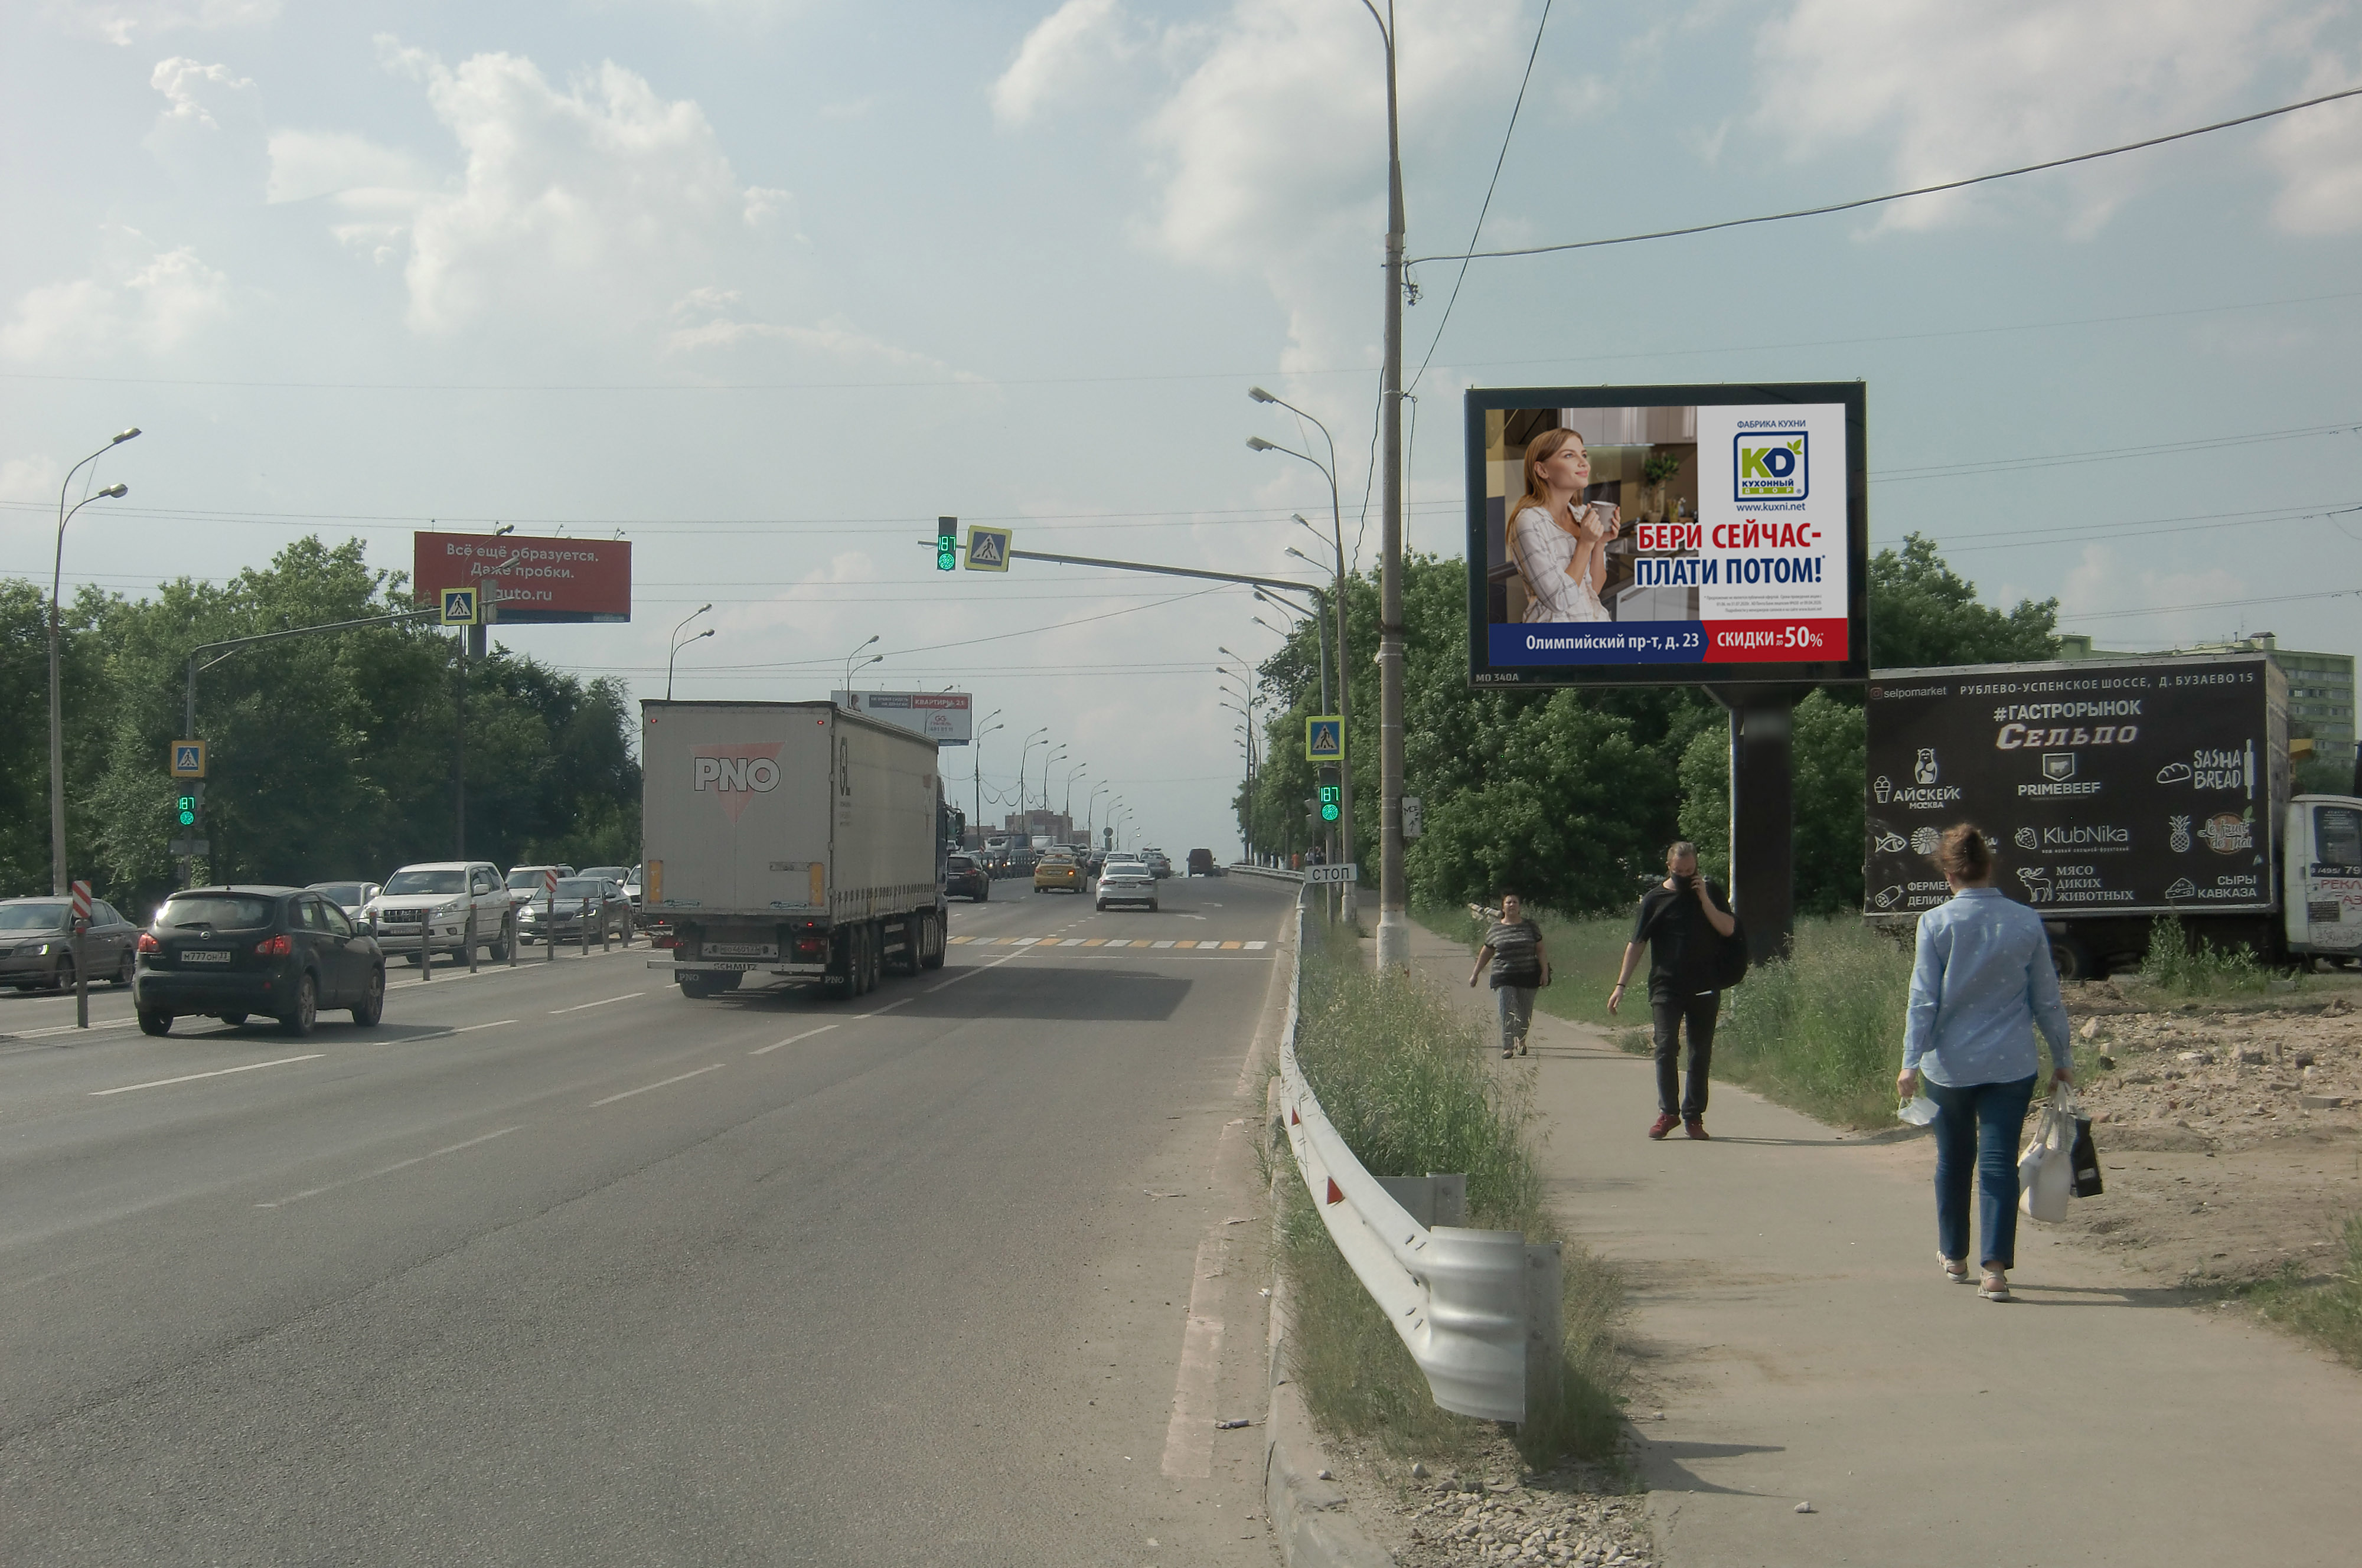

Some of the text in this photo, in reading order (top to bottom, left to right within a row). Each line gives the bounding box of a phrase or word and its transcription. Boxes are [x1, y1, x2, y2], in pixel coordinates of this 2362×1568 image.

[1742, 479, 1794, 487] КУХОННЫЙ
[1737, 503, 1806, 511] www.kuxni.net
[1639, 519, 1822, 549] БЕРИ СЕЙЧАС-
[938, 537, 955, 551] 187
[447, 544, 599, 563] Всё ещё образуется.
[471, 562, 575, 579] Даже пробки.
[1637, 559, 1718, 585] ПЛАТИ
[1526, 633, 1699, 651] Олимпийский пр-т, д. 23
[1717, 631, 1774, 649] СКИДКИ
[1960, 673, 2253, 695] РУБЛЕВО-УСПЕНСКОЕ ШОССЕ, Д. БУЗАЕВО 15
[1884, 687, 1947, 700] selpomarket
[1994, 700, 2142, 721] #ГАСТРОРЫНОК
[2193, 749, 2241, 769] SASHA
[694, 757, 781, 792] PNO
[2194, 769, 2241, 789] BREAD
[1320, 787, 1339, 802] 187
[1893, 786, 1961, 802] АЙСКЕЙК
[2018, 782, 2101, 796] PRIMEBEEF
[179, 797, 194, 809] 187
[2044, 825, 2128, 844] KlubNika
[1313, 868, 1349, 880] СТОП
[2056, 865, 2093, 876] МЯСО
[1907, 881, 1950, 891] ФЕРМЕР
[2056, 878, 2101, 890] ДИКИХ
[2217, 875, 2256, 885] СЫРЫ
[2056, 891, 2134, 901] ЖИВОТНЫХ
[2198, 888, 2257, 898] КАВКАЗА
[1907, 896, 1955, 907] ДЕЛИКА
